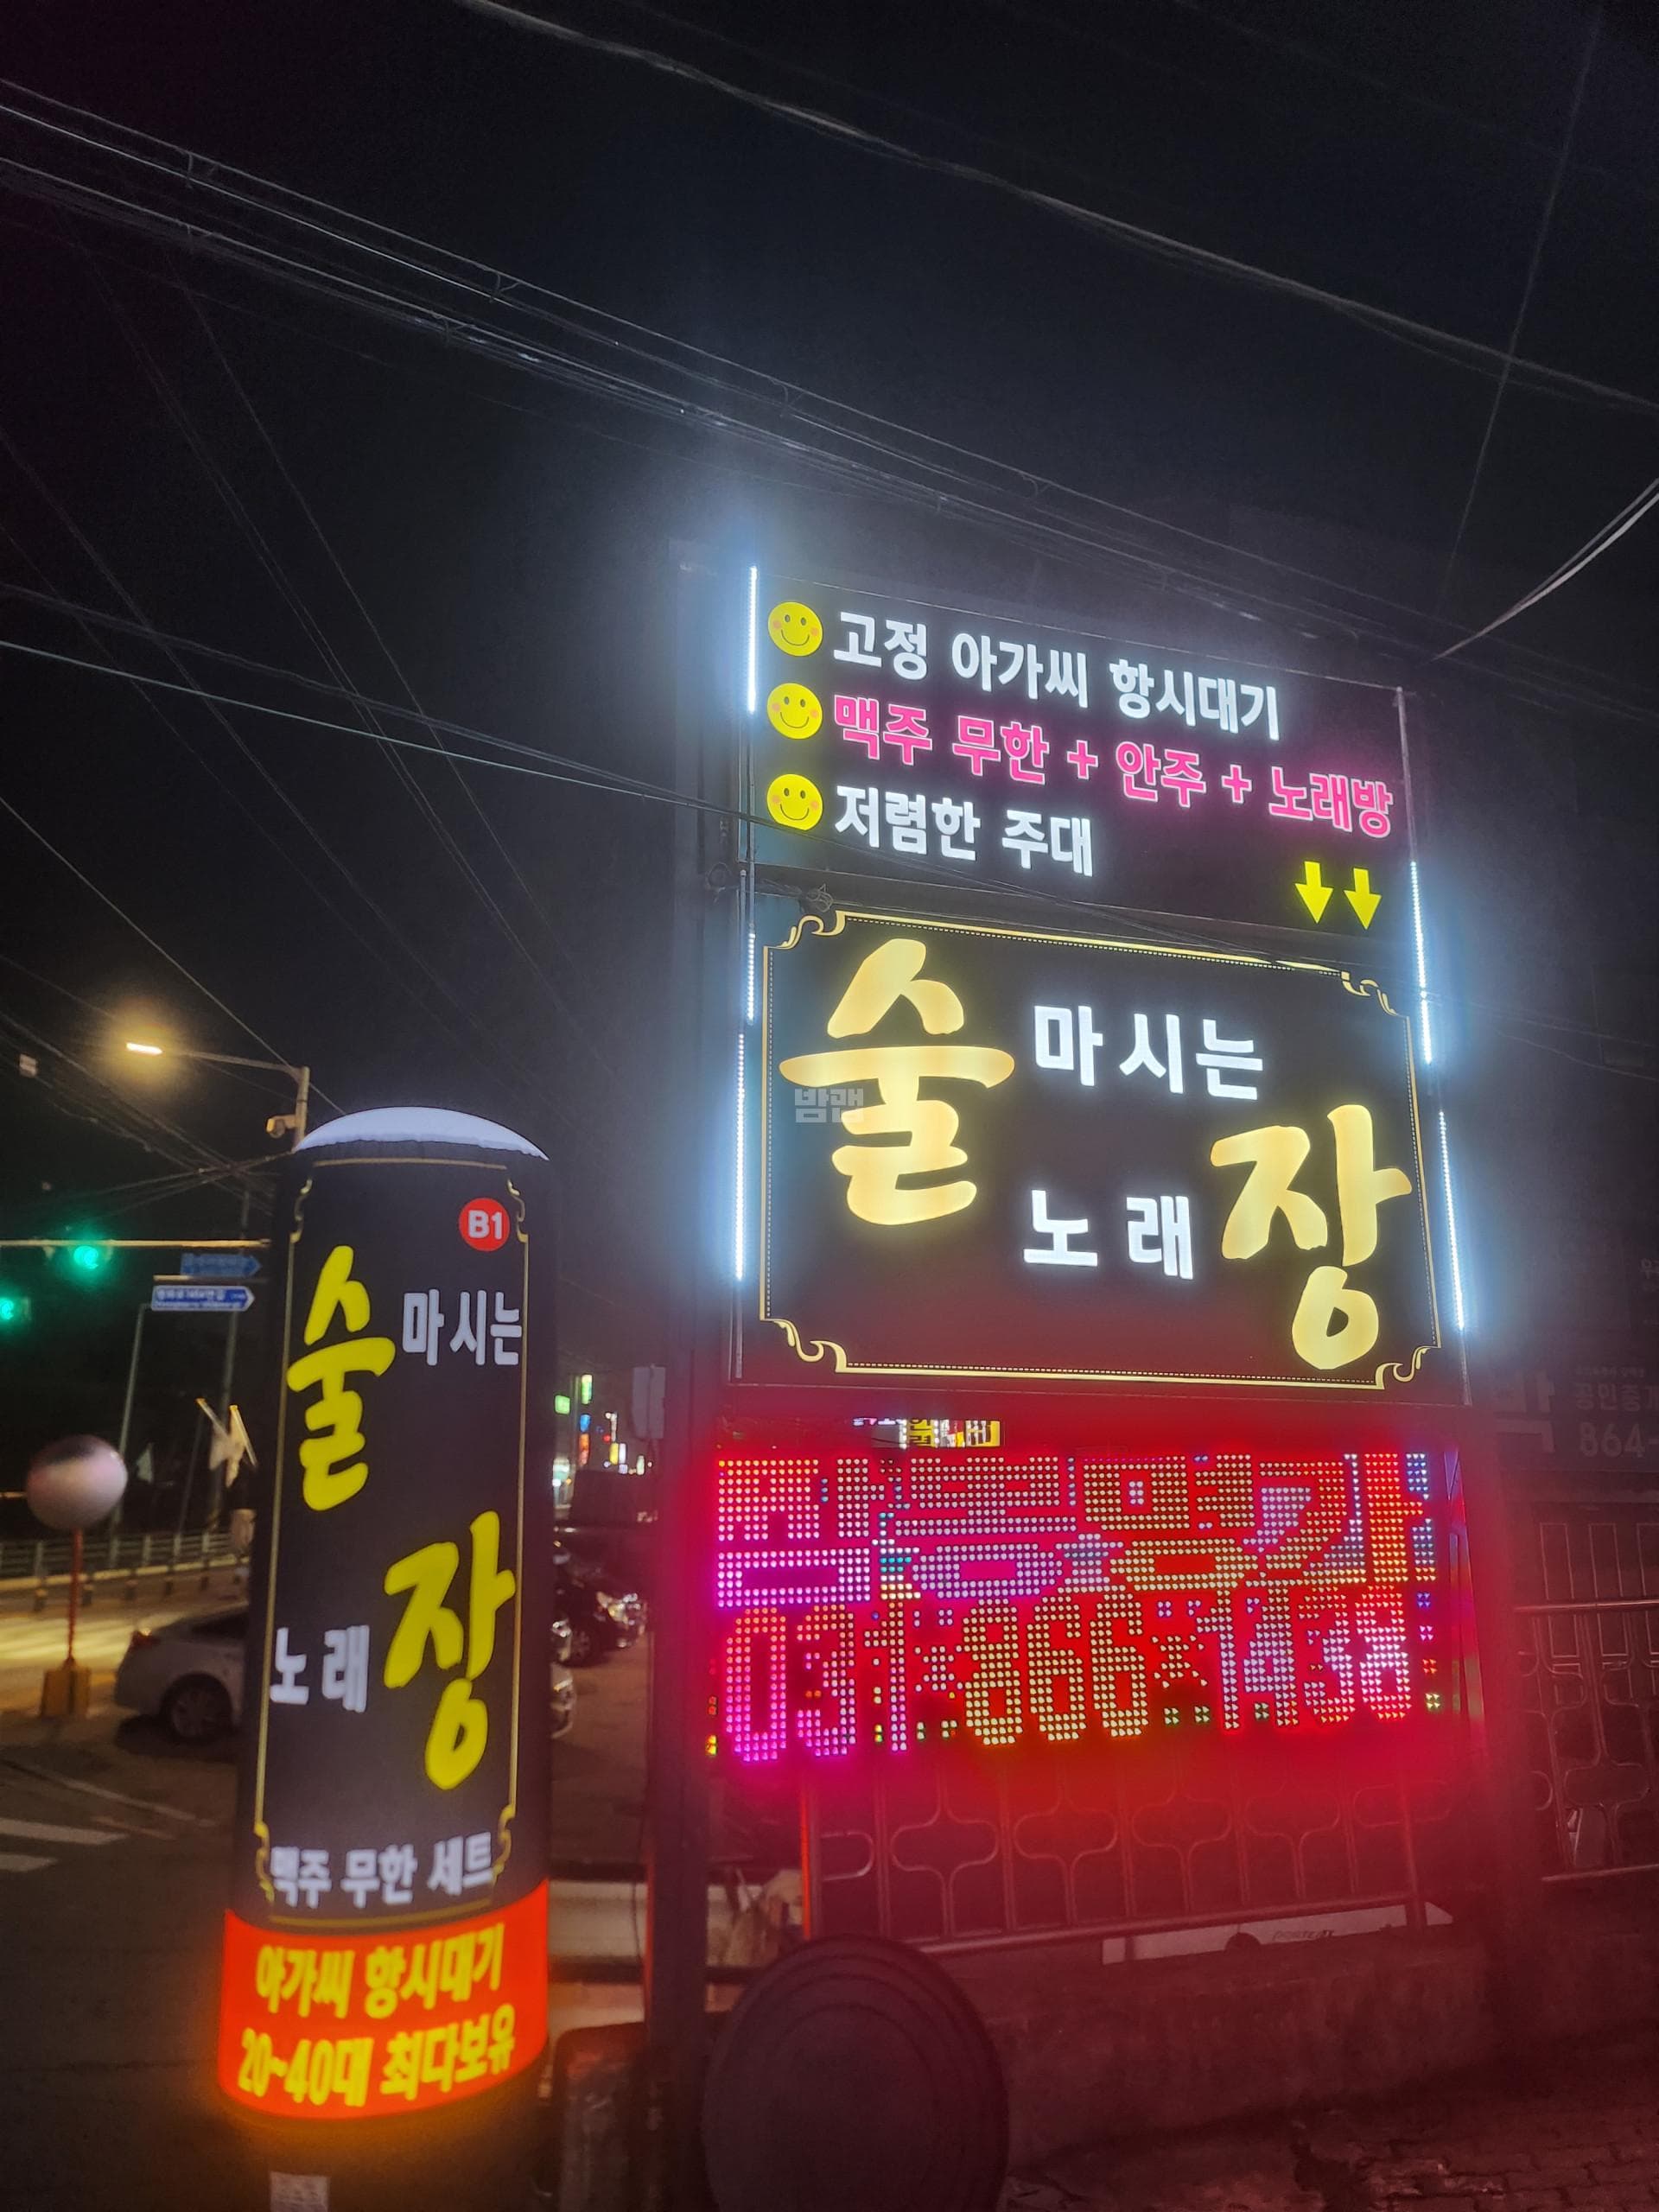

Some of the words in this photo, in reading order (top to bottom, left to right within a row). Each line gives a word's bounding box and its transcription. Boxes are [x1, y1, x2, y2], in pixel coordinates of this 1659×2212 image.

[833, 610, 928, 681] 고정
[951, 632, 1089, 709] 아가씨
[1109, 658, 1280, 741] 항시대기
[834, 694, 933, 766] 맥주
[951, 714, 1050, 785] 무한
[1115, 741, 1207, 810] 안주
[1268, 764, 1395, 839] 노래방
[835, 784, 981, 861] 저렴한
[1001, 808, 1094, 878] 주대
[779, 938, 1015, 1226] 술
[1033, 1004, 1264, 1101] 마시는
[468, 1209, 504, 1240] B1
[286, 1244, 397, 1512] 술
[402, 1287, 523, 1367] 마시는
[270, 1845, 333, 1910] 맥주
[340, 1843, 420, 1909] 무한
[427, 1831, 493, 1896] 세트
[256, 1944, 356, 2019] 아가씨
[364, 1922, 505, 2019] 항시대기
[237, 2026, 375, 2108] 20~40대
[378, 2003, 516, 2101] 최다보유
